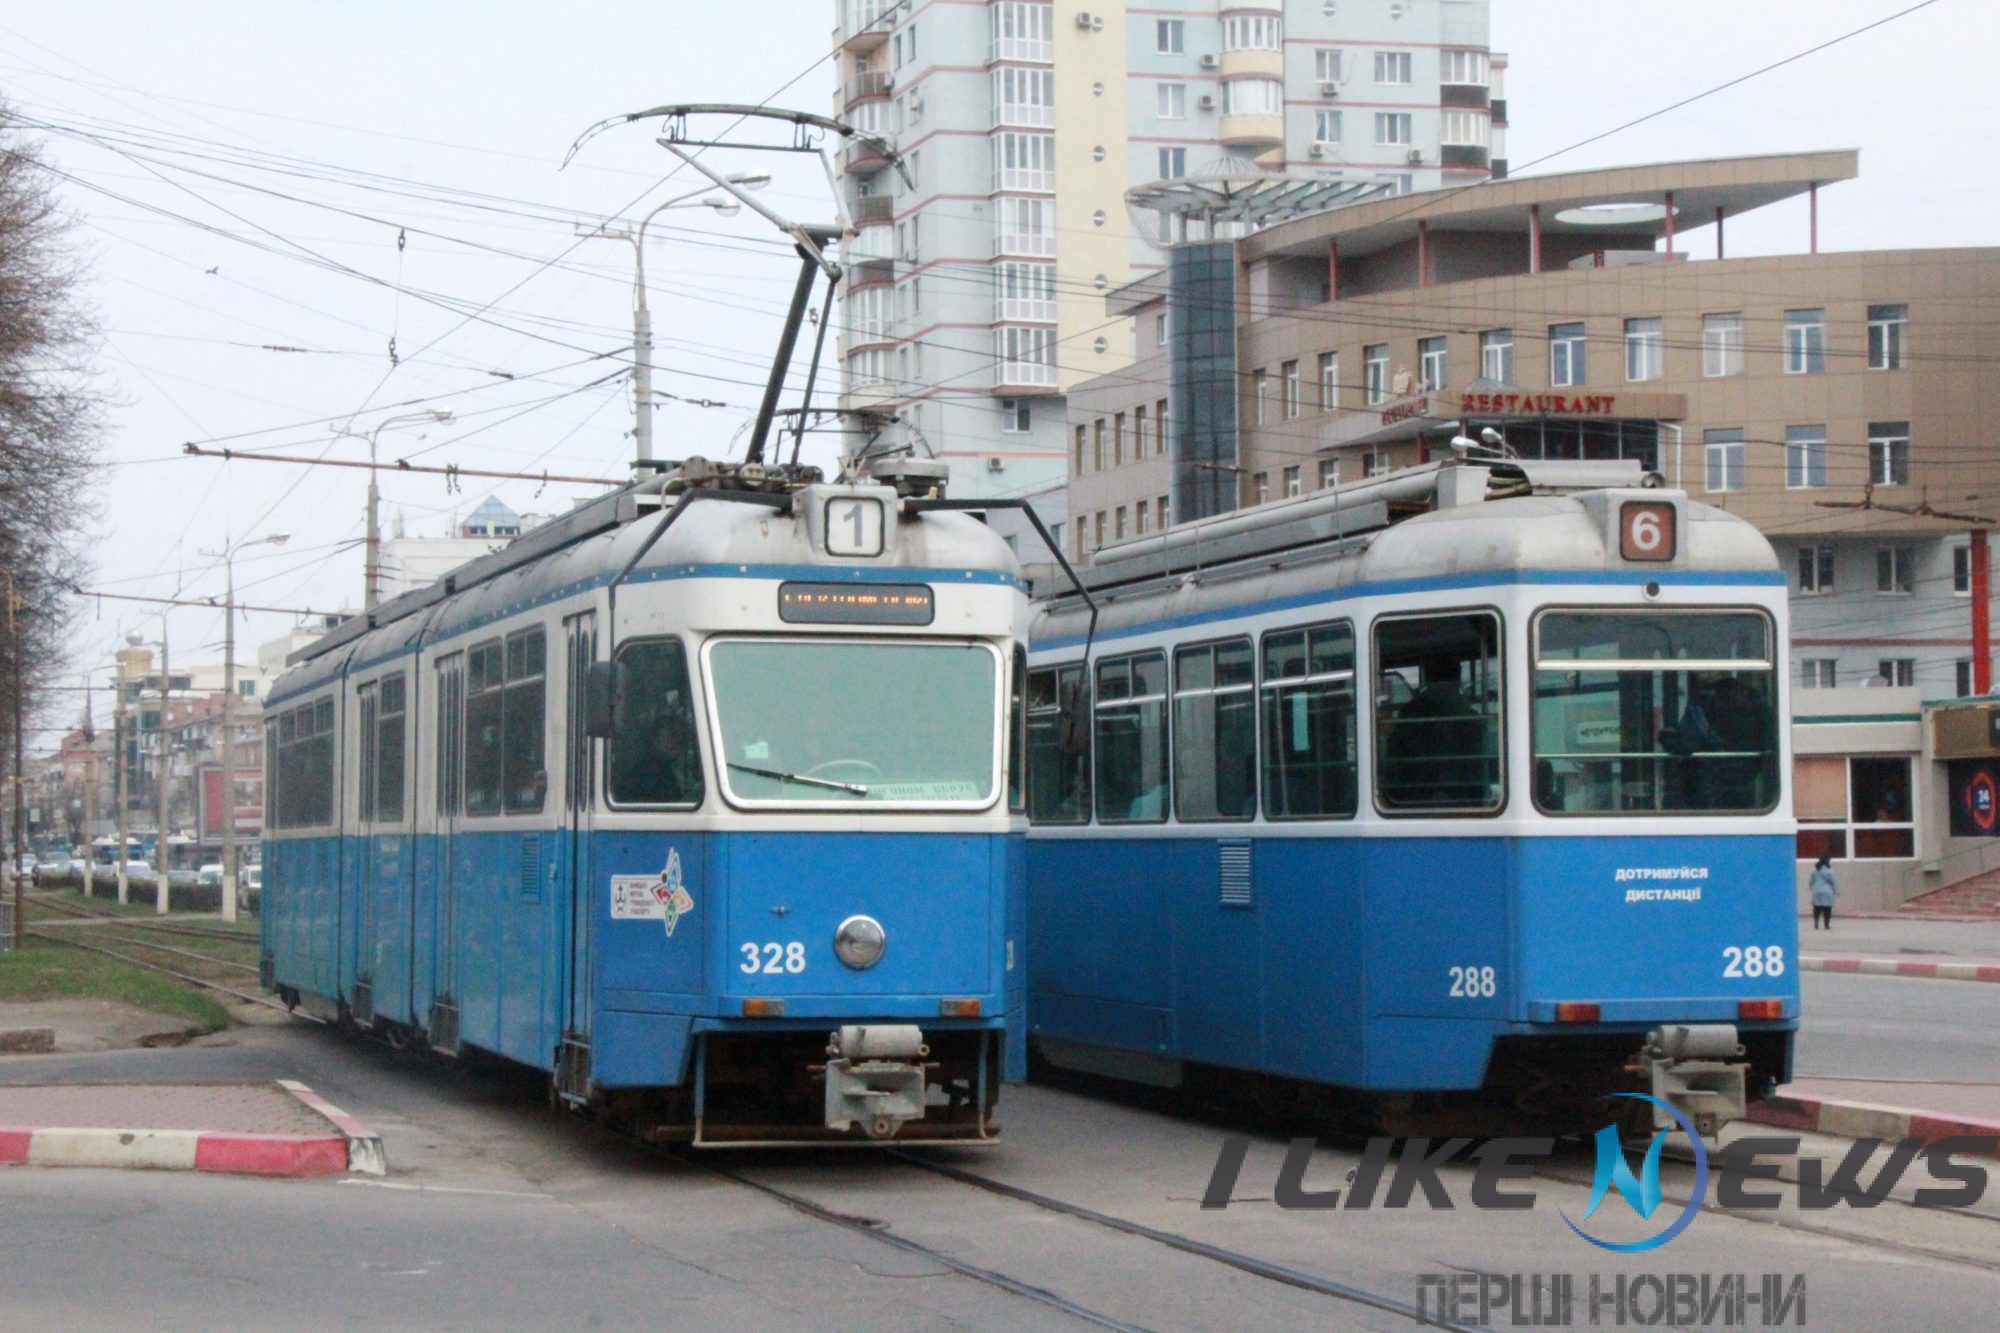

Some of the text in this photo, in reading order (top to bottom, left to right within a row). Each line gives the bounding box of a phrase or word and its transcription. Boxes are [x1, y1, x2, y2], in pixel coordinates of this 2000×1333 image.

[1461, 393, 1615, 414] RESTAURANT
[843, 503, 863, 548] 1
[1631, 511, 1661, 551] 6
[1615, 867, 1709, 881] ДОТРИМУЙСЯ
[1625, 887, 1702, 902] ДИСТАНЦІЇ
[740, 942, 806, 974] 328
[1723, 945, 1786, 978] 288
[1448, 966, 1496, 998] 288
